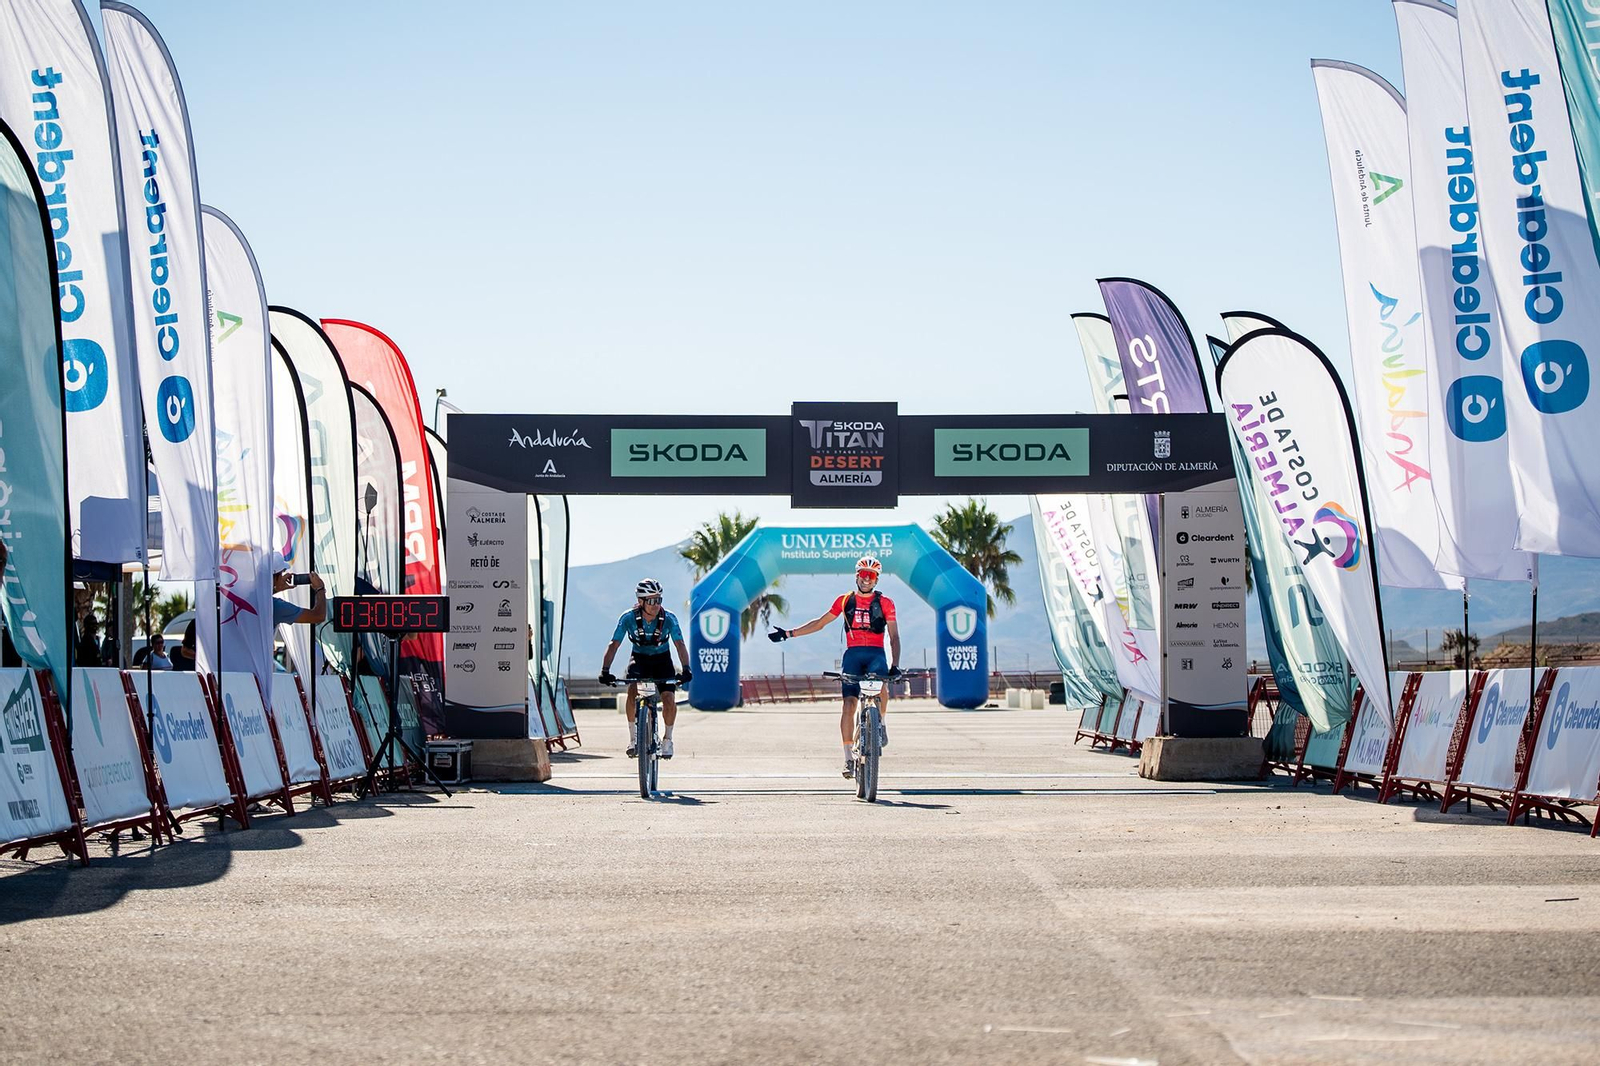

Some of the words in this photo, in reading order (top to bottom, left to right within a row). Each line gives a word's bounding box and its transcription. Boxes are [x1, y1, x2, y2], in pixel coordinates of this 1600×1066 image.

[508, 428, 592, 449] Andalucía
[799, 420, 884, 449] TITAN
[810, 456, 884, 468] DESERT
[1106, 461, 1163, 472] DIPUTACIÓN
[1165, 462, 1177, 471] DE
[1178, 460, 1218, 471] ALMERÍA
[819, 472, 872, 484] ALMERÍA
[1195, 505, 1228, 513] ALMERÍA
[781, 533, 893, 549] UNIVERSAE
[1191, 533, 1235, 542] Cleardent
[781, 550, 821, 559] Instituto
[823, 549, 864, 560] Superior
[865, 549, 877, 558] de
[879, 548, 893, 558] FP
[340, 601, 439, 628] 03:08:52
[698, 647, 730, 656] CHANGE
[946, 645, 978, 653] CHANGE
[698, 654, 729, 664] YOUR
[946, 652, 978, 661] YOUR
[700, 662, 729, 673] WAY
[948, 660, 978, 671] WAY
[1496, 699, 1528, 727] Cleardent
[166, 711, 209, 742] Cleardent
